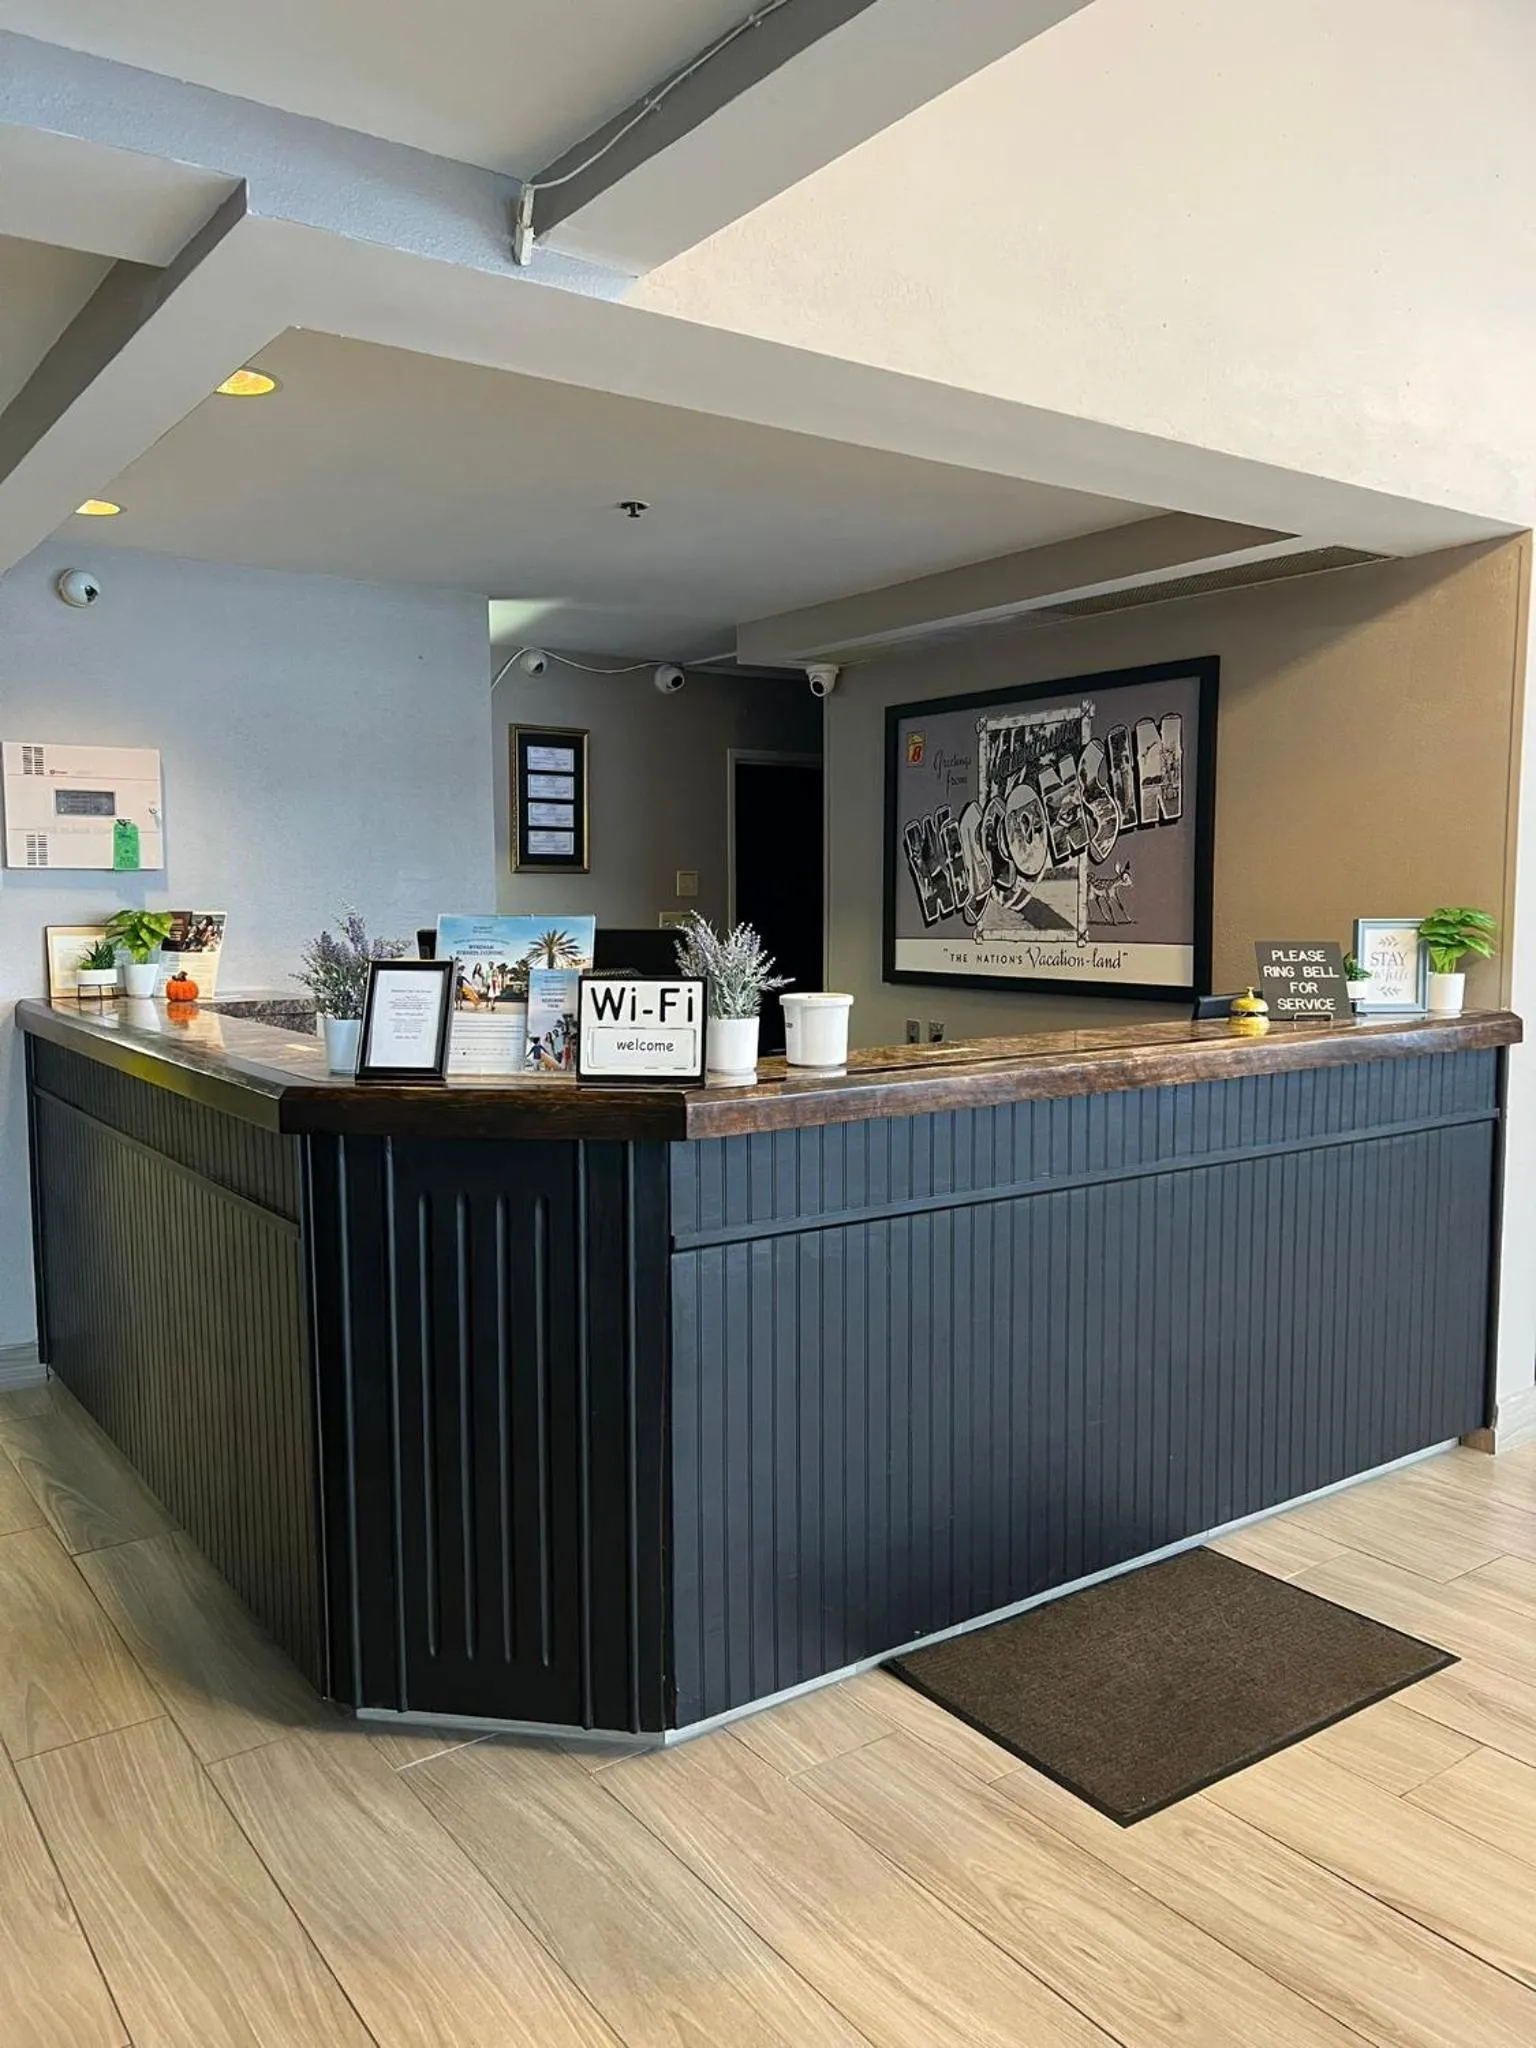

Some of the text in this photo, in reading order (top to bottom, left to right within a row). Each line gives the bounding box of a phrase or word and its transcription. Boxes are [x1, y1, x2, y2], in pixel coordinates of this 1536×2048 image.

[976, 953, 1023, 965] NATION'S
[1271, 949, 1327, 962] PLEASE
[1370, 951, 1408, 967] STAY
[1262, 965, 1341, 978] RING BELL
[1289, 981, 1319, 994] FOR
[590, 986, 694, 1023] Wi-Fi
[1277, 998, 1337, 1011] SERVICE
[616, 1037, 675, 1052] welcome
